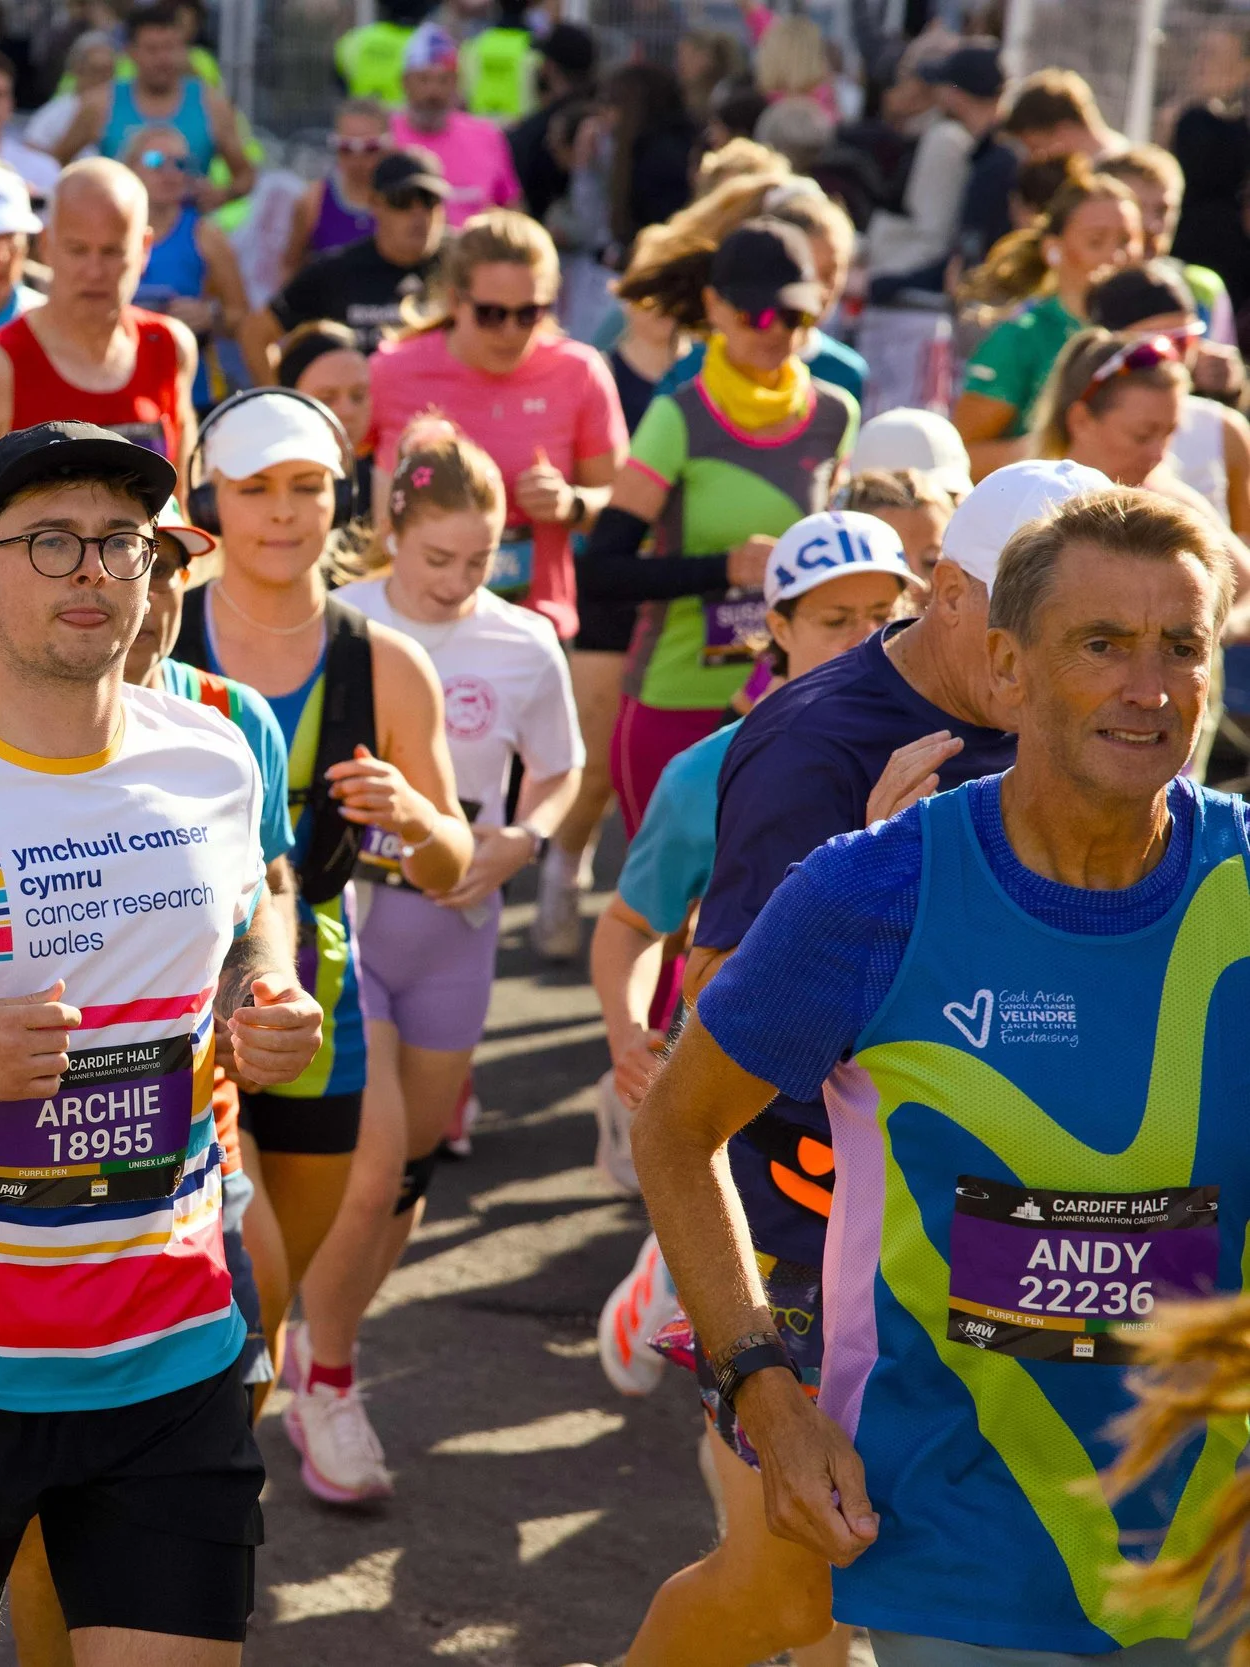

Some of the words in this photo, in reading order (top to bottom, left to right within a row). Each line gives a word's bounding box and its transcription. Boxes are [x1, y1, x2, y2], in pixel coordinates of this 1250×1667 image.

[12, 832, 127, 871] ymchwil
[128, 825, 208, 851] canser
[19, 868, 102, 899] cymru
[25, 900, 110, 927] cancer
[112, 881, 215, 917] research
[29, 930, 104, 959] wales
[999, 989, 1029, 1003] Codi
[1033, 990, 1074, 1003] Arian
[999, 1011, 1077, 1023] VELINDRE
[1000, 1029, 1079, 1048] Fundraising
[69, 1052, 123, 1072] CARDIFF
[127, 1047, 160, 1065] HALF
[69, 1072, 95, 1081] HANNER
[95, 1066, 129, 1077] MARATHON
[35, 1084, 161, 1128] ARCHIE
[48, 1122, 154, 1162] 18955
[19, 1169, 50, 1177] PURPLE
[51, 1168, 67, 1176] PEN
[128, 1159, 156, 1169] UNISEX
[156, 1154, 177, 1165] LARGE
[0, 1183, 27, 1196] R4W
[1052, 1199, 1127, 1214] CARDIFF
[1131, 1197, 1169, 1214] HALF
[1051, 1215, 1085, 1223] HANNER
[1086, 1216, 1132, 1225] MARATHON
[1133, 1214, 1169, 1225] CAERDYDD
[1026, 1239, 1152, 1274] ANDY
[1018, 1275, 1155, 1315] 22236
[987, 1309, 1022, 1324] PURPLE
[1024, 1317, 1044, 1326] PEN
[965, 1321, 997, 1338] R4W
